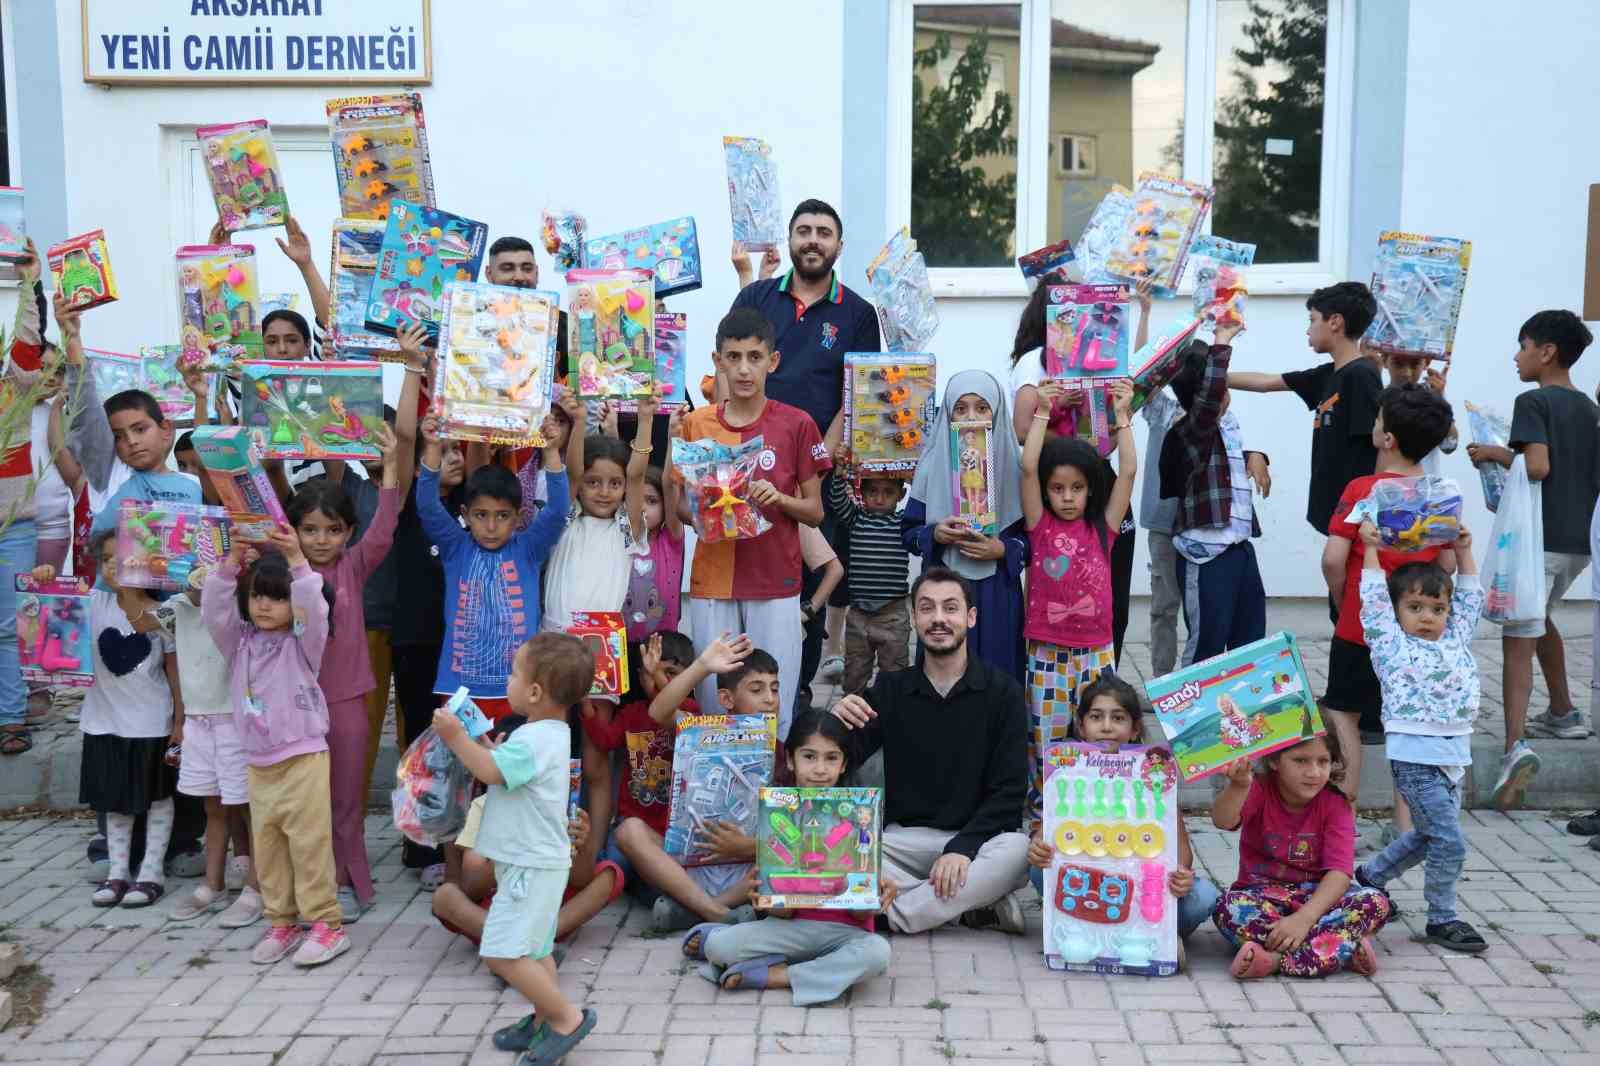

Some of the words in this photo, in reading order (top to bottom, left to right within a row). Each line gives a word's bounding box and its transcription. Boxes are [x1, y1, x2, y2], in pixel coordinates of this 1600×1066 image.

[101, 25, 171, 70] YENİ
[183, 26, 274, 71] CAMİİ
[286, 25, 416, 70] DERNEĞİ
[1158, 680, 1201, 712] sandy
